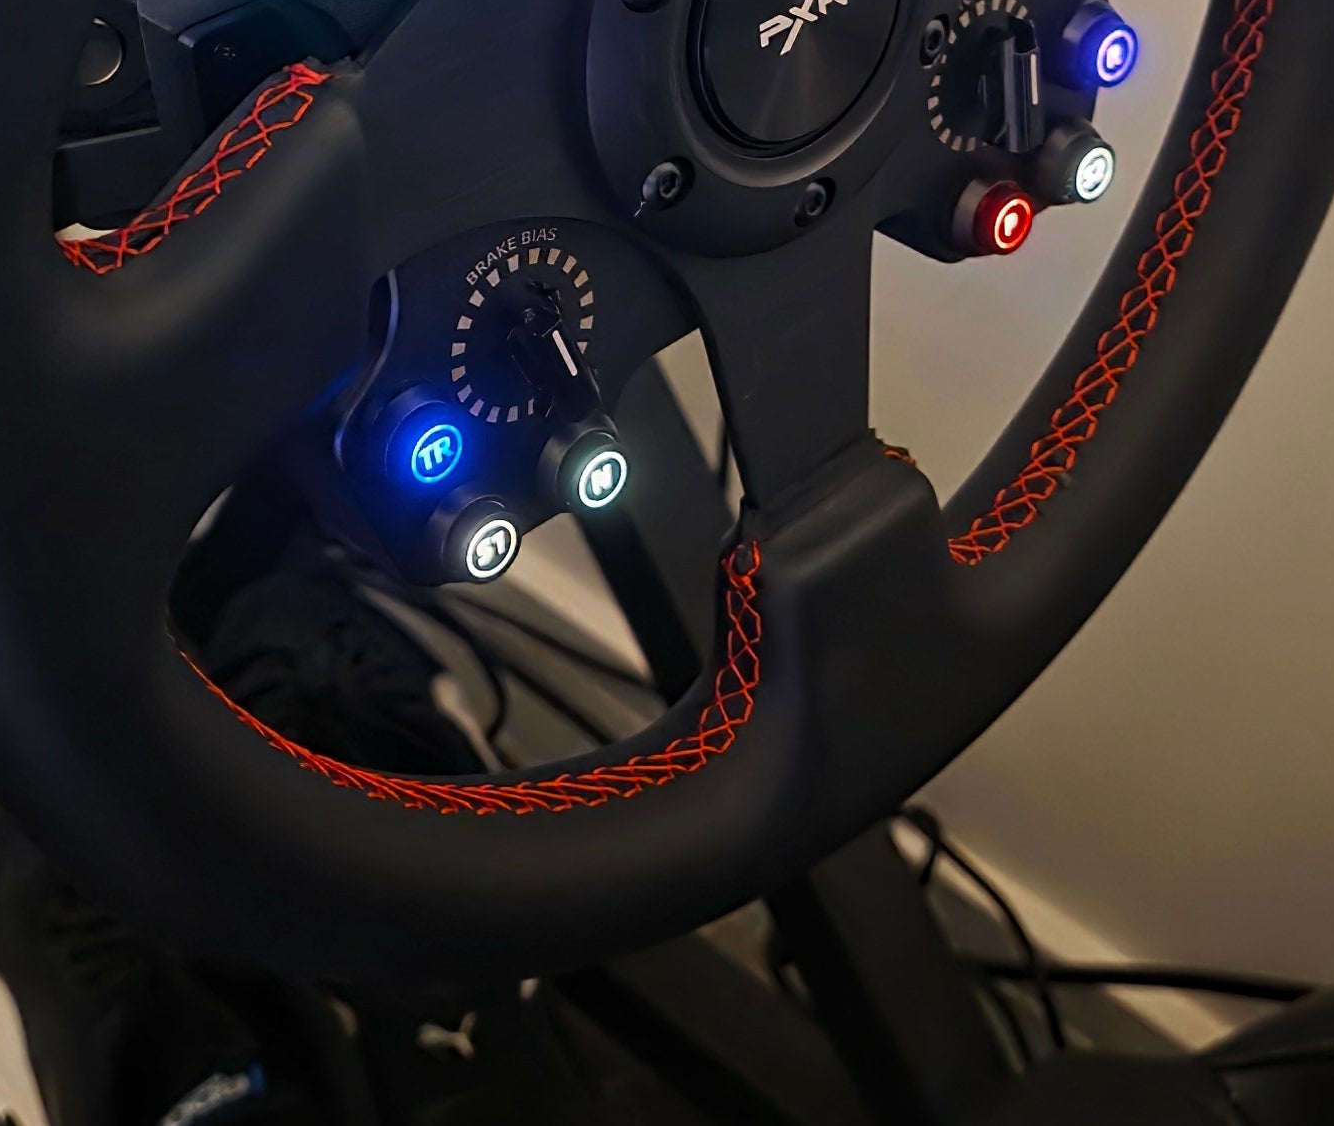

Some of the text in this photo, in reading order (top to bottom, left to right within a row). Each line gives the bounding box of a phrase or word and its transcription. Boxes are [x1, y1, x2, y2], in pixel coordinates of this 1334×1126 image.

[466, 227, 558, 285] BRAKE BIAS
[417, 435, 456, 470] TR
[590, 463, 615, 496] N
[475, 529, 507, 567] S1
